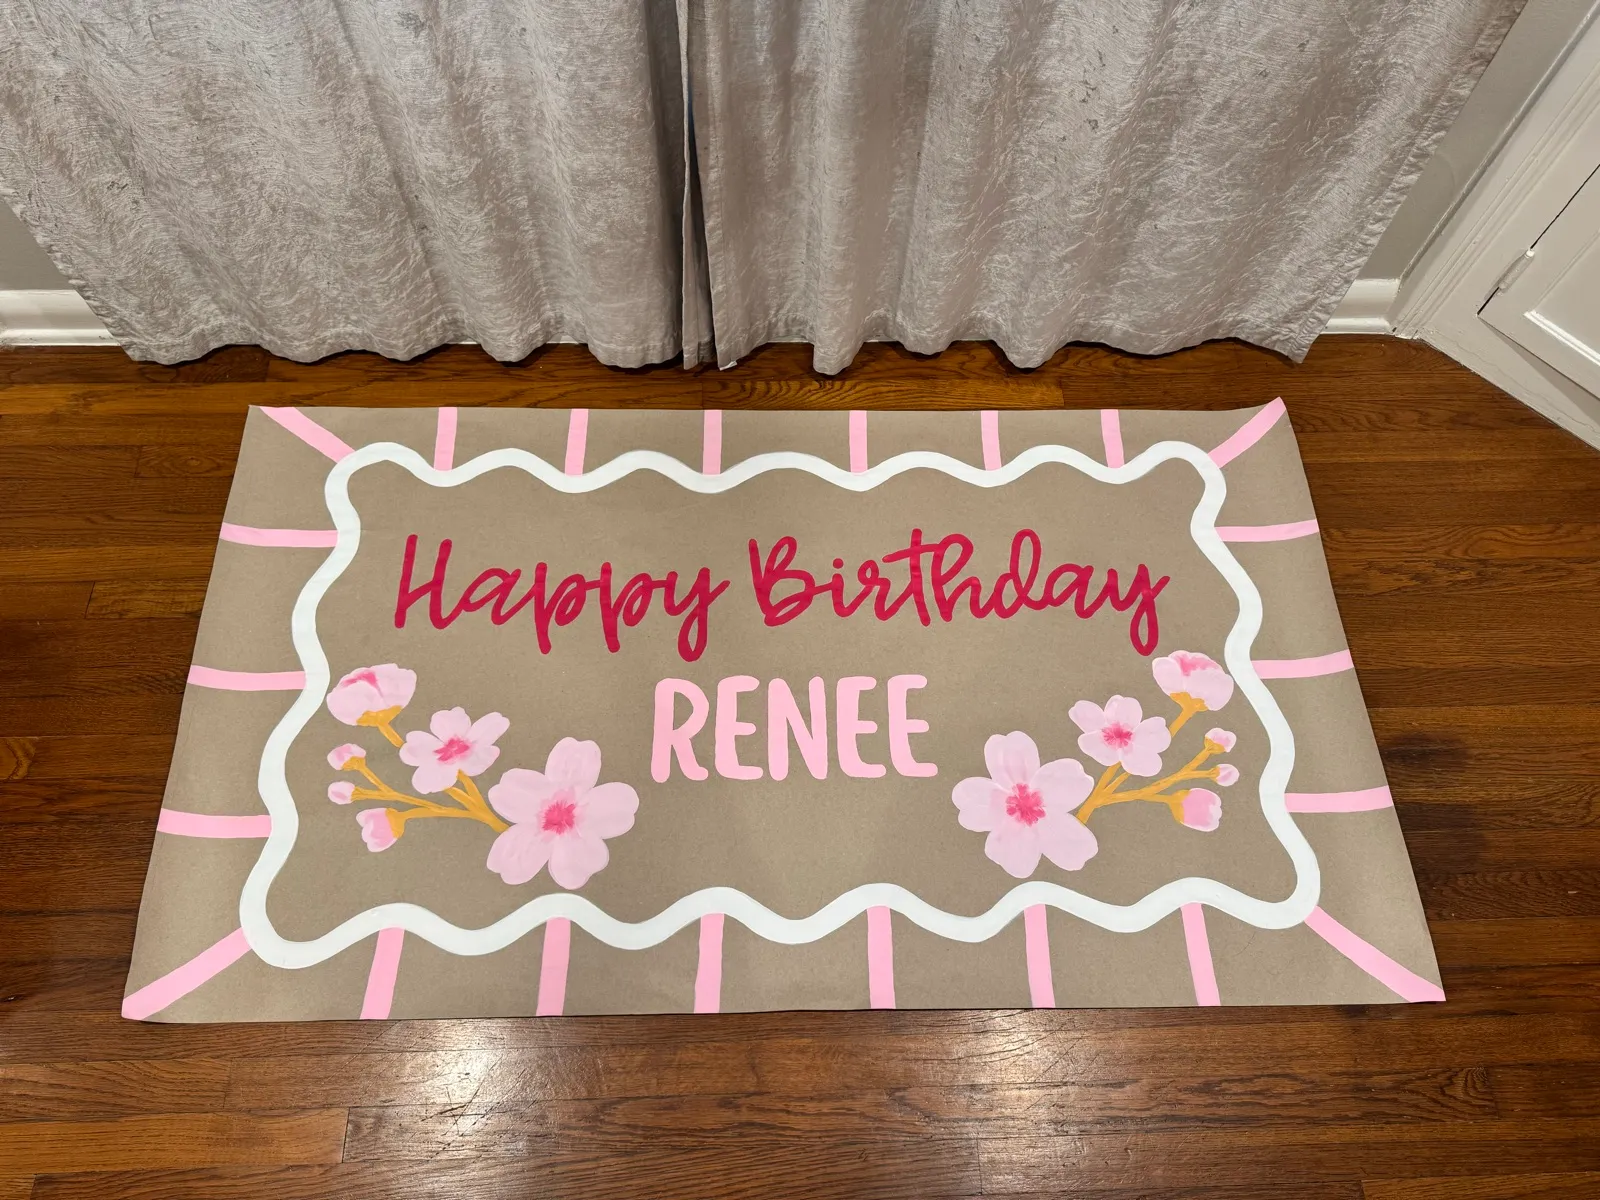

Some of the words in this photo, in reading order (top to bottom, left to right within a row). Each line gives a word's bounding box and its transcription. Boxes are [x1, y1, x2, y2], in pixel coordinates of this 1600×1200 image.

[394, 533, 730, 663] Happy
[748, 527, 1170, 657] Birthday
[650, 674, 938, 784] RENEE
